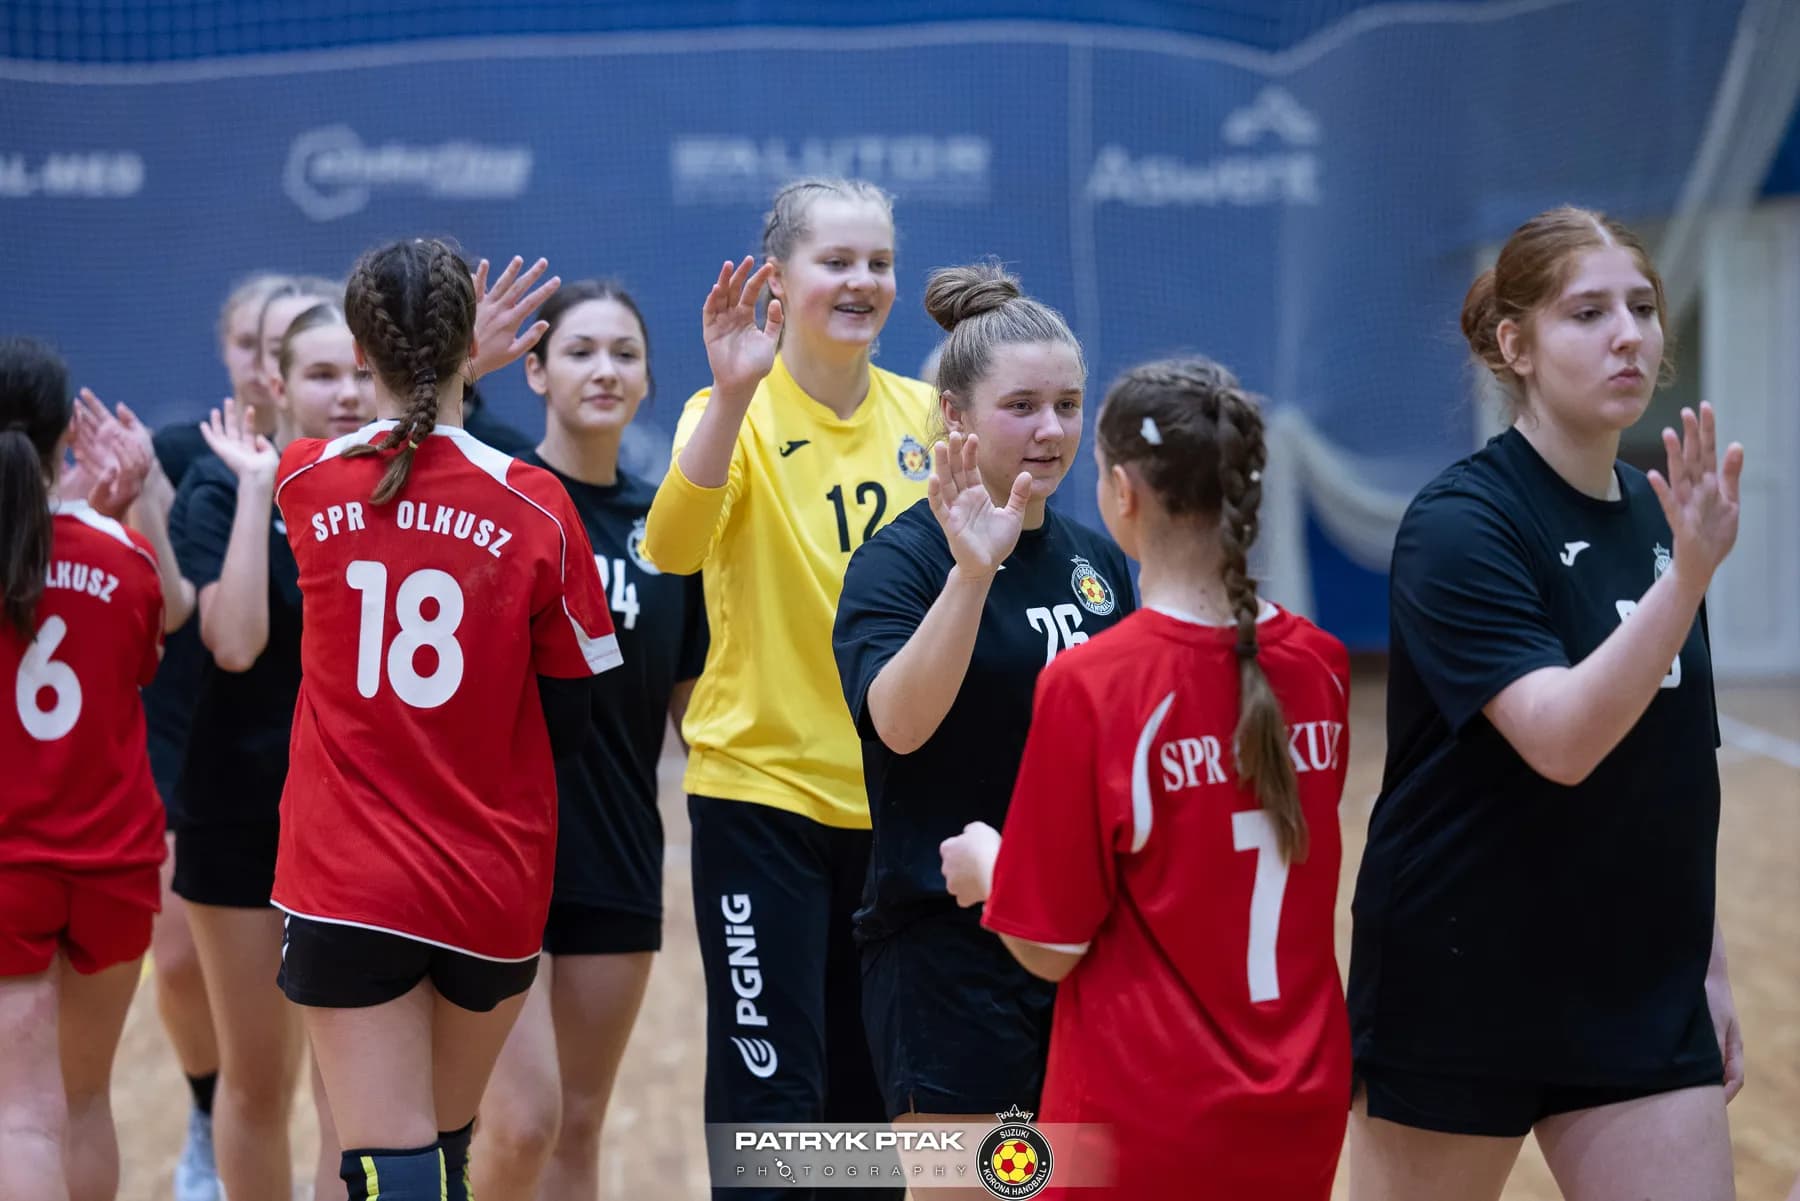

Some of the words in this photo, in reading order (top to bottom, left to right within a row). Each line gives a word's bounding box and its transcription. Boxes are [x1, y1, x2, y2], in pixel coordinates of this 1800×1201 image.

[312, 501, 366, 542] SPR
[397, 500, 513, 558] OLKUSZ
[825, 481, 887, 553] 12
[45, 560, 119, 603] LKUSZ
[346, 560, 464, 709] 18
[16, 614, 82, 741] 6
[1160, 735, 1229, 792] SPR
[721, 893, 769, 1027] PGNiG
